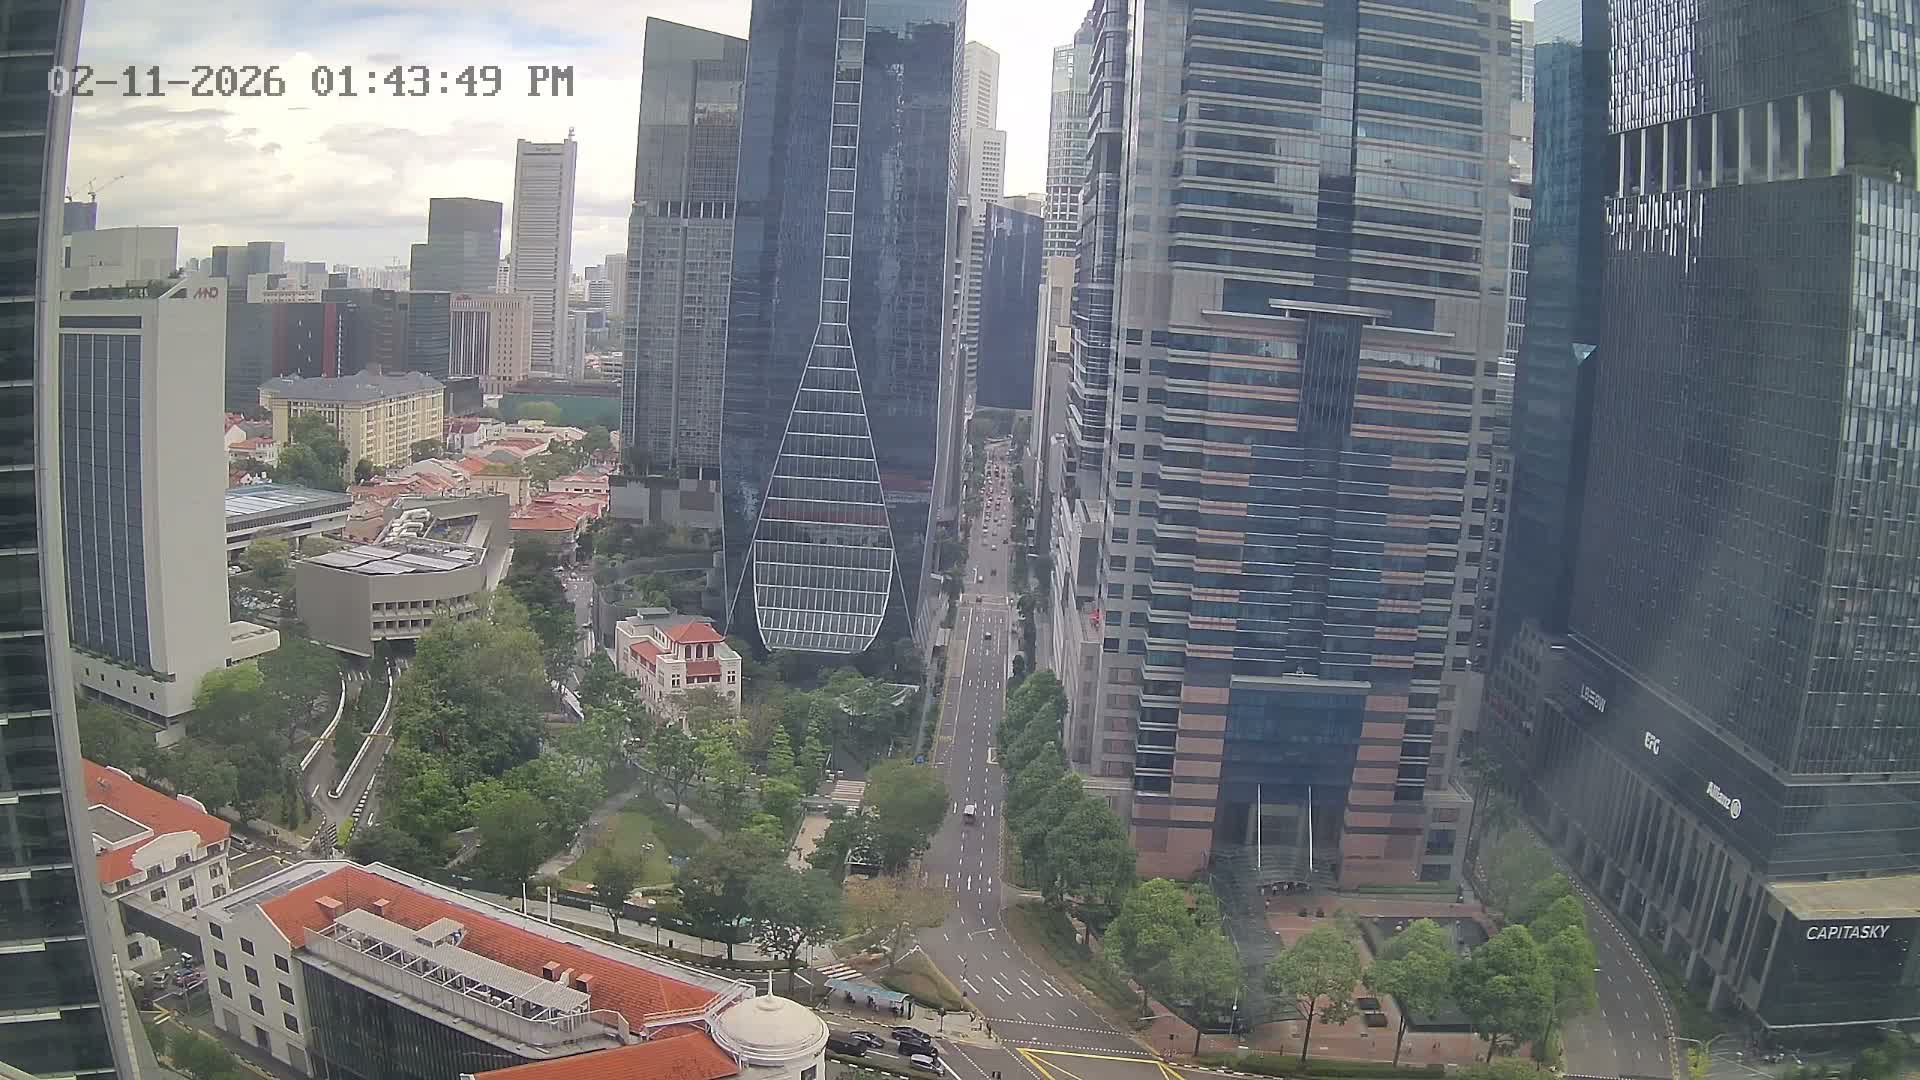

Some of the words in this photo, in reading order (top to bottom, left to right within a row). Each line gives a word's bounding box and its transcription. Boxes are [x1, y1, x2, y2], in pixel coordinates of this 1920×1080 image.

[1645, 731, 1661, 755] EFG
[1706, 781, 1731, 810] Allianz
[1806, 924, 1891, 940] CAPITASKY
